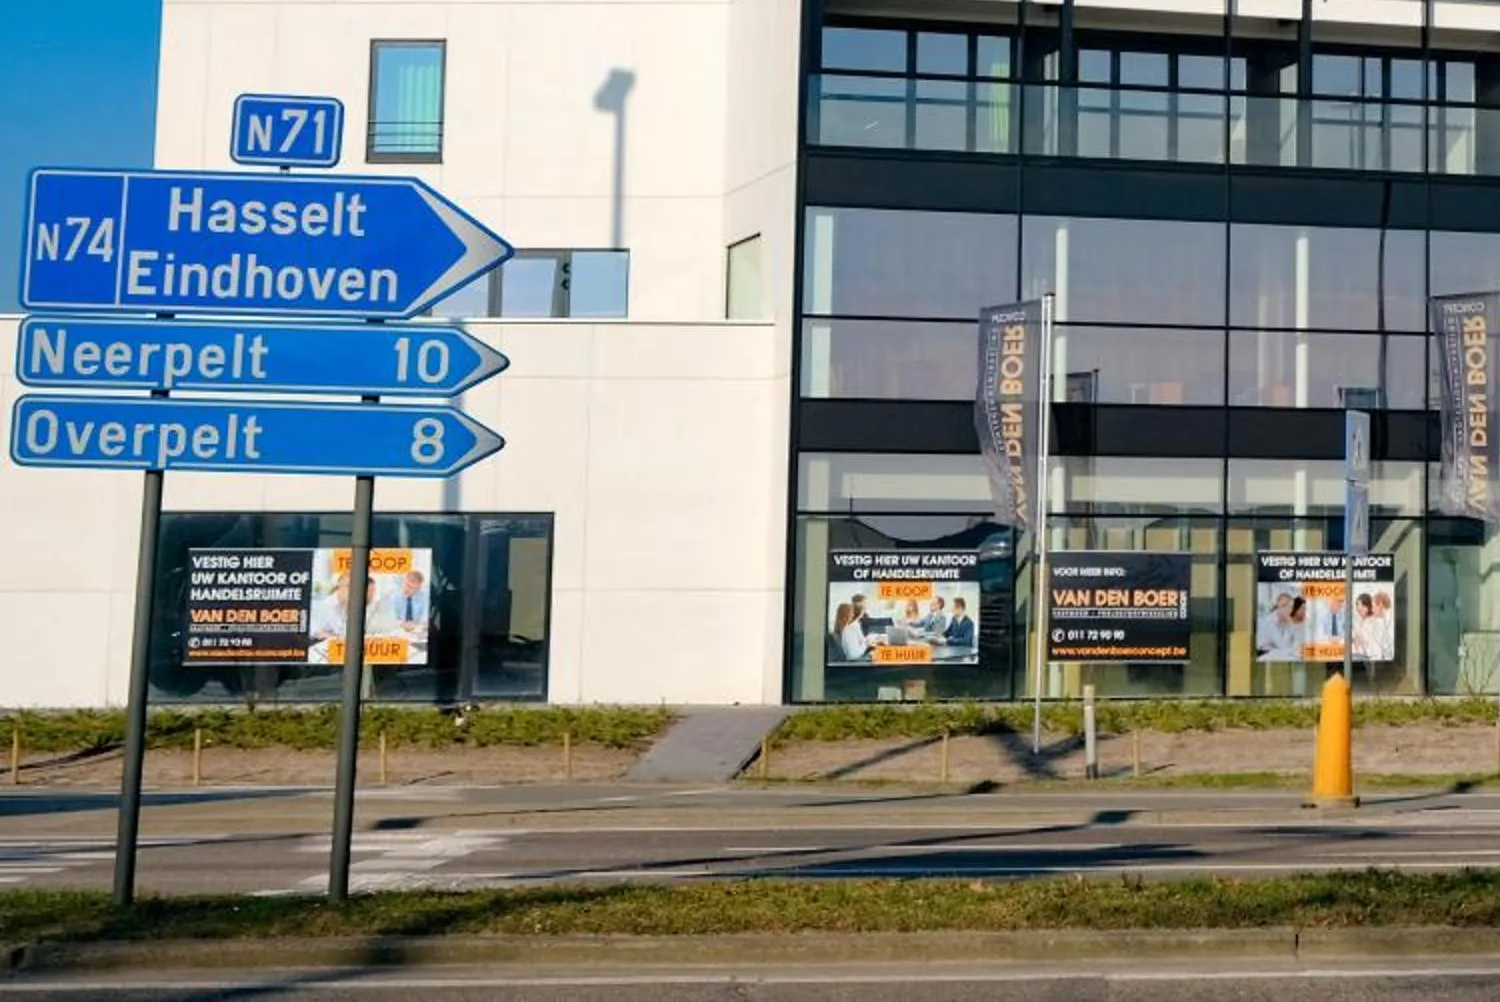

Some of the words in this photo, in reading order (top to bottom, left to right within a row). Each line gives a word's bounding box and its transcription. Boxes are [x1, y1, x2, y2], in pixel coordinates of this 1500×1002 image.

[246, 107, 327, 155] N71
[167, 186, 367, 237] Hasselt
[35, 216, 115, 263] N74
[126, 249, 399, 303] Eindhoven
[30, 328, 269, 387] Neerpelt
[393, 337, 450, 384] 10
[25, 408, 263, 469] Overpelt
[410, 417, 446, 465] 8
[192, 556, 240, 569] VESTIG
[243, 556, 274, 569] HIER
[369, 556, 407, 570] OOP
[834, 555, 872, 566] VESTIG
[875, 555, 899, 566] HIER
[901, 555, 919, 565] UW
[922, 555, 977, 566] KANTOOR
[191, 572, 214, 585] UW
[217, 572, 286, 585] KANTOOR
[289, 572, 310, 584] OF
[853, 569, 870, 579] OF
[190, 587, 302, 601] HANDELSRUIMTE
[1052, 590, 1090, 606] VAN
[1095, 590, 1129, 606] DEN
[1133, 590, 1178, 606] BOER
[191, 609, 223, 623] VAN
[226, 609, 257, 623] DEN
[260, 609, 299, 623] BOER
[369, 643, 401, 656] UUR
